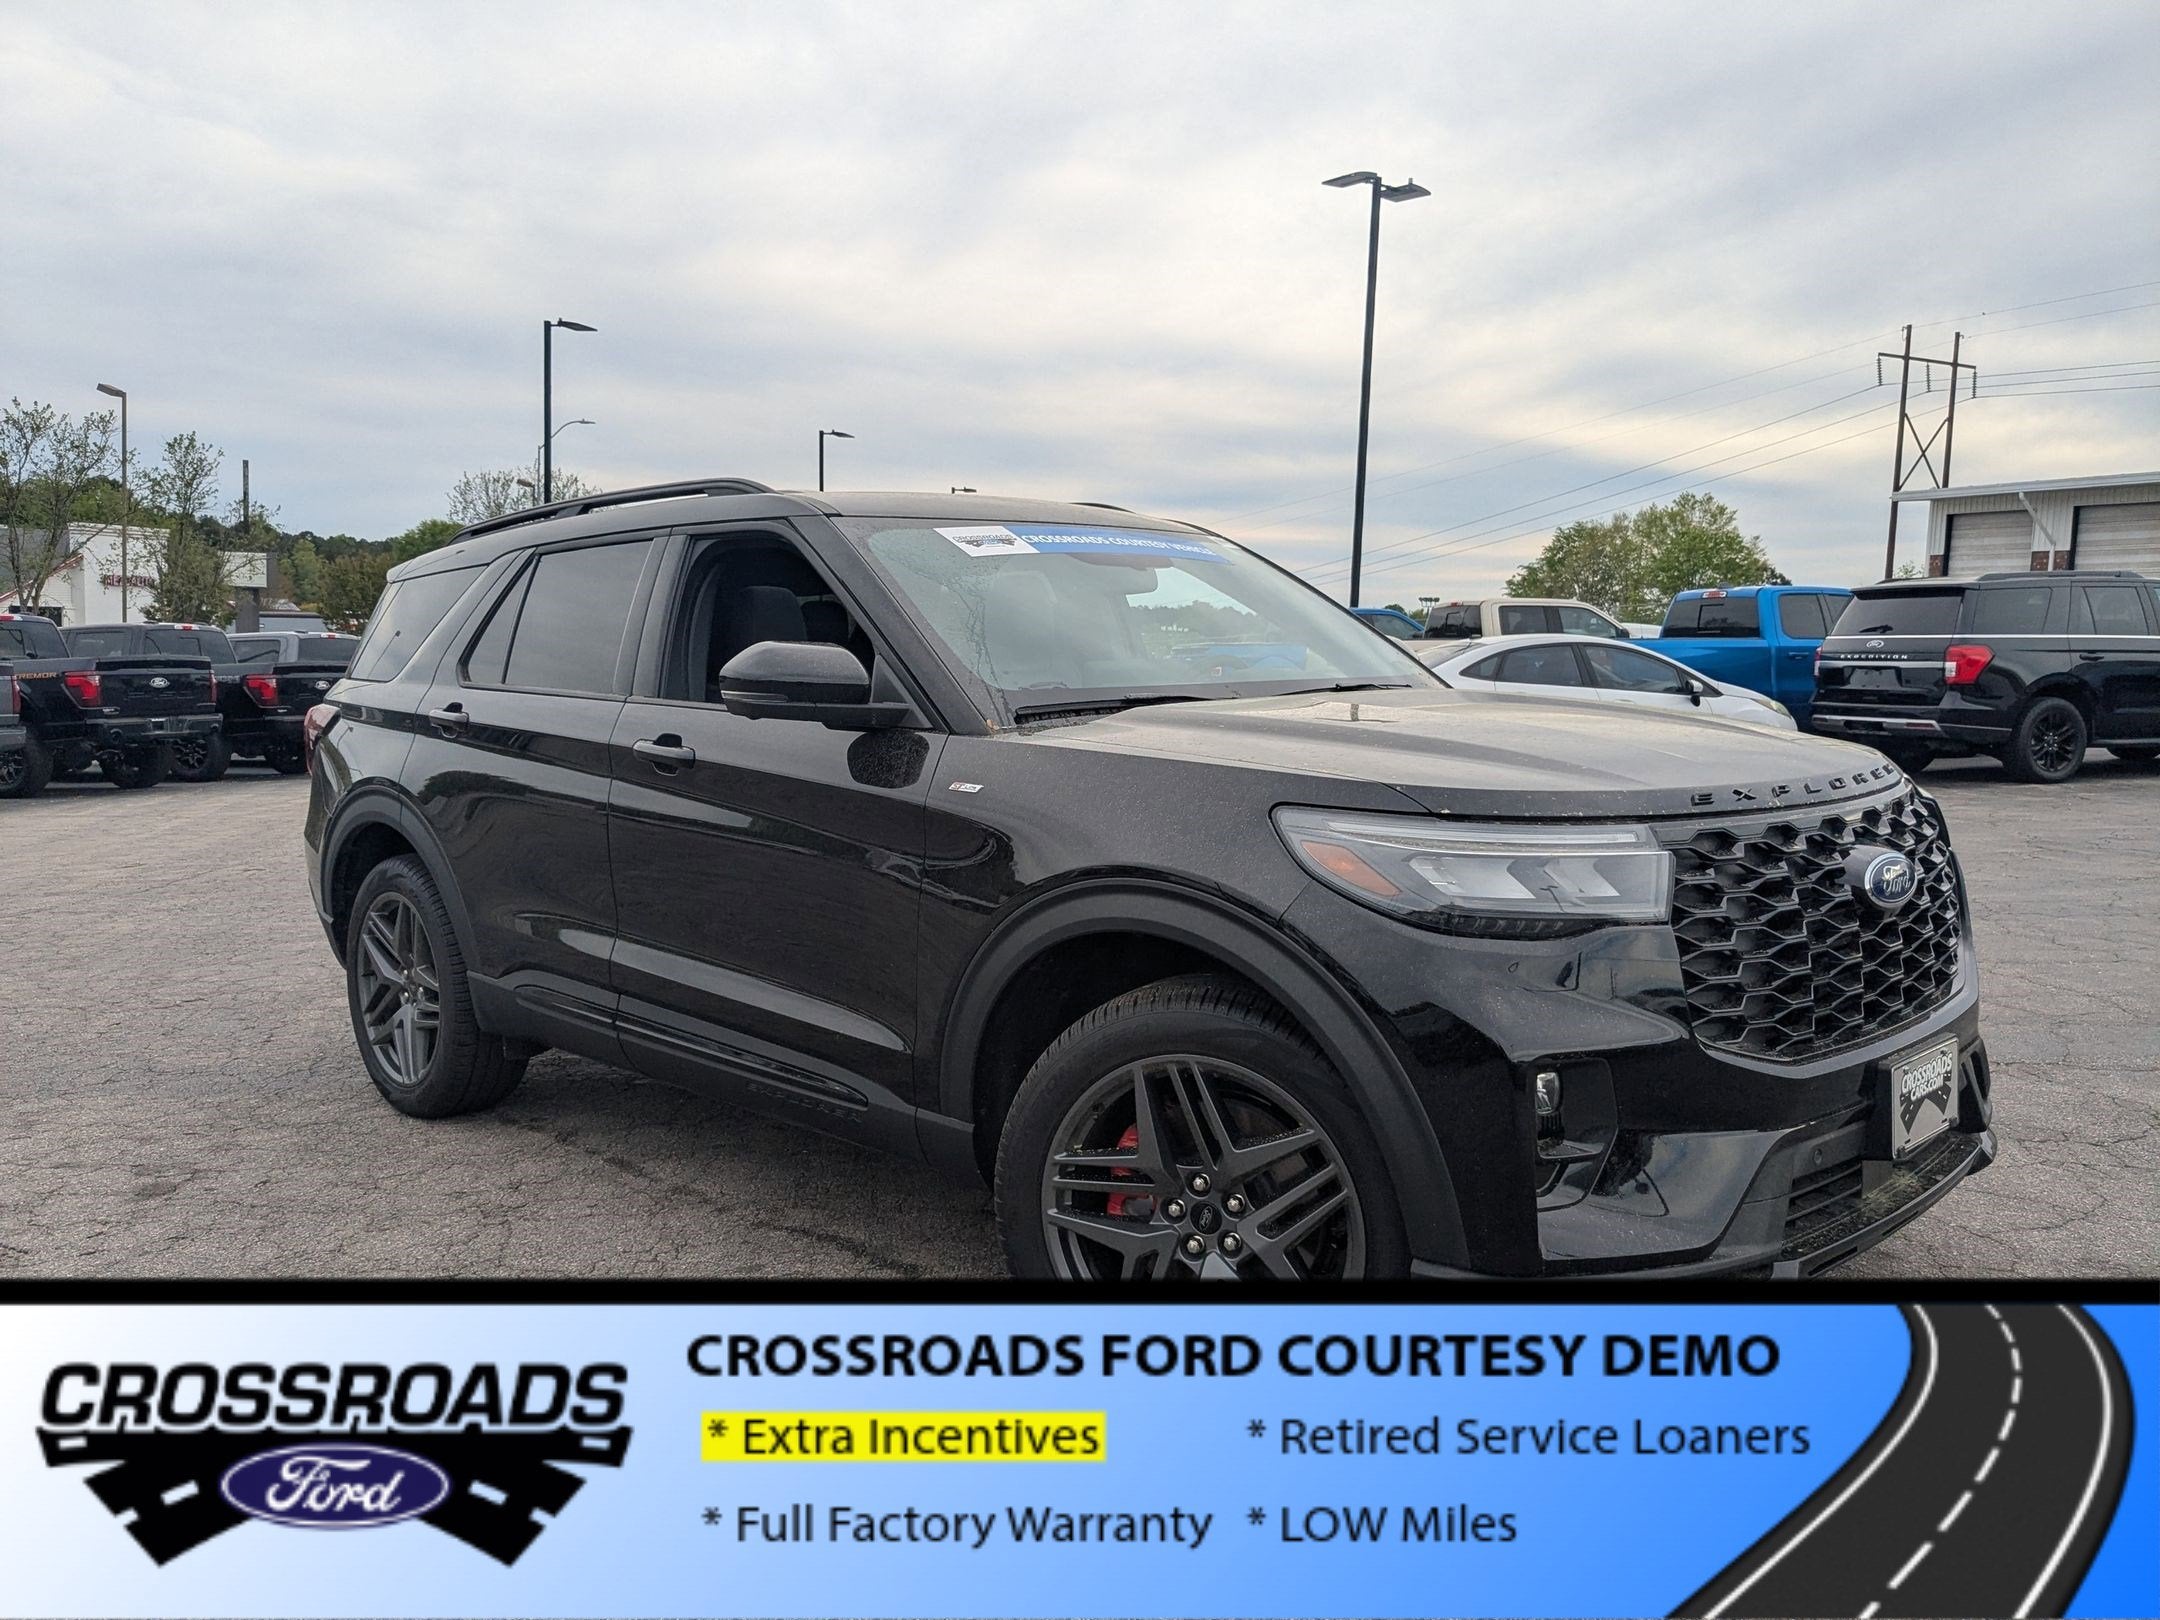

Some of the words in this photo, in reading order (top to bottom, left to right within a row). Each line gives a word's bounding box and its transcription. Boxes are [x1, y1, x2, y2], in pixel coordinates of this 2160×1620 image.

[1022, 533, 1110, 545] CROSSROADS
[1109, 536, 1170, 551] COURTESY
[15, 671, 58, 680] TREMOR
[1901, 1052, 1953, 1094] CROSSROADS
[1910, 1074, 1944, 1102] CARS.COM
